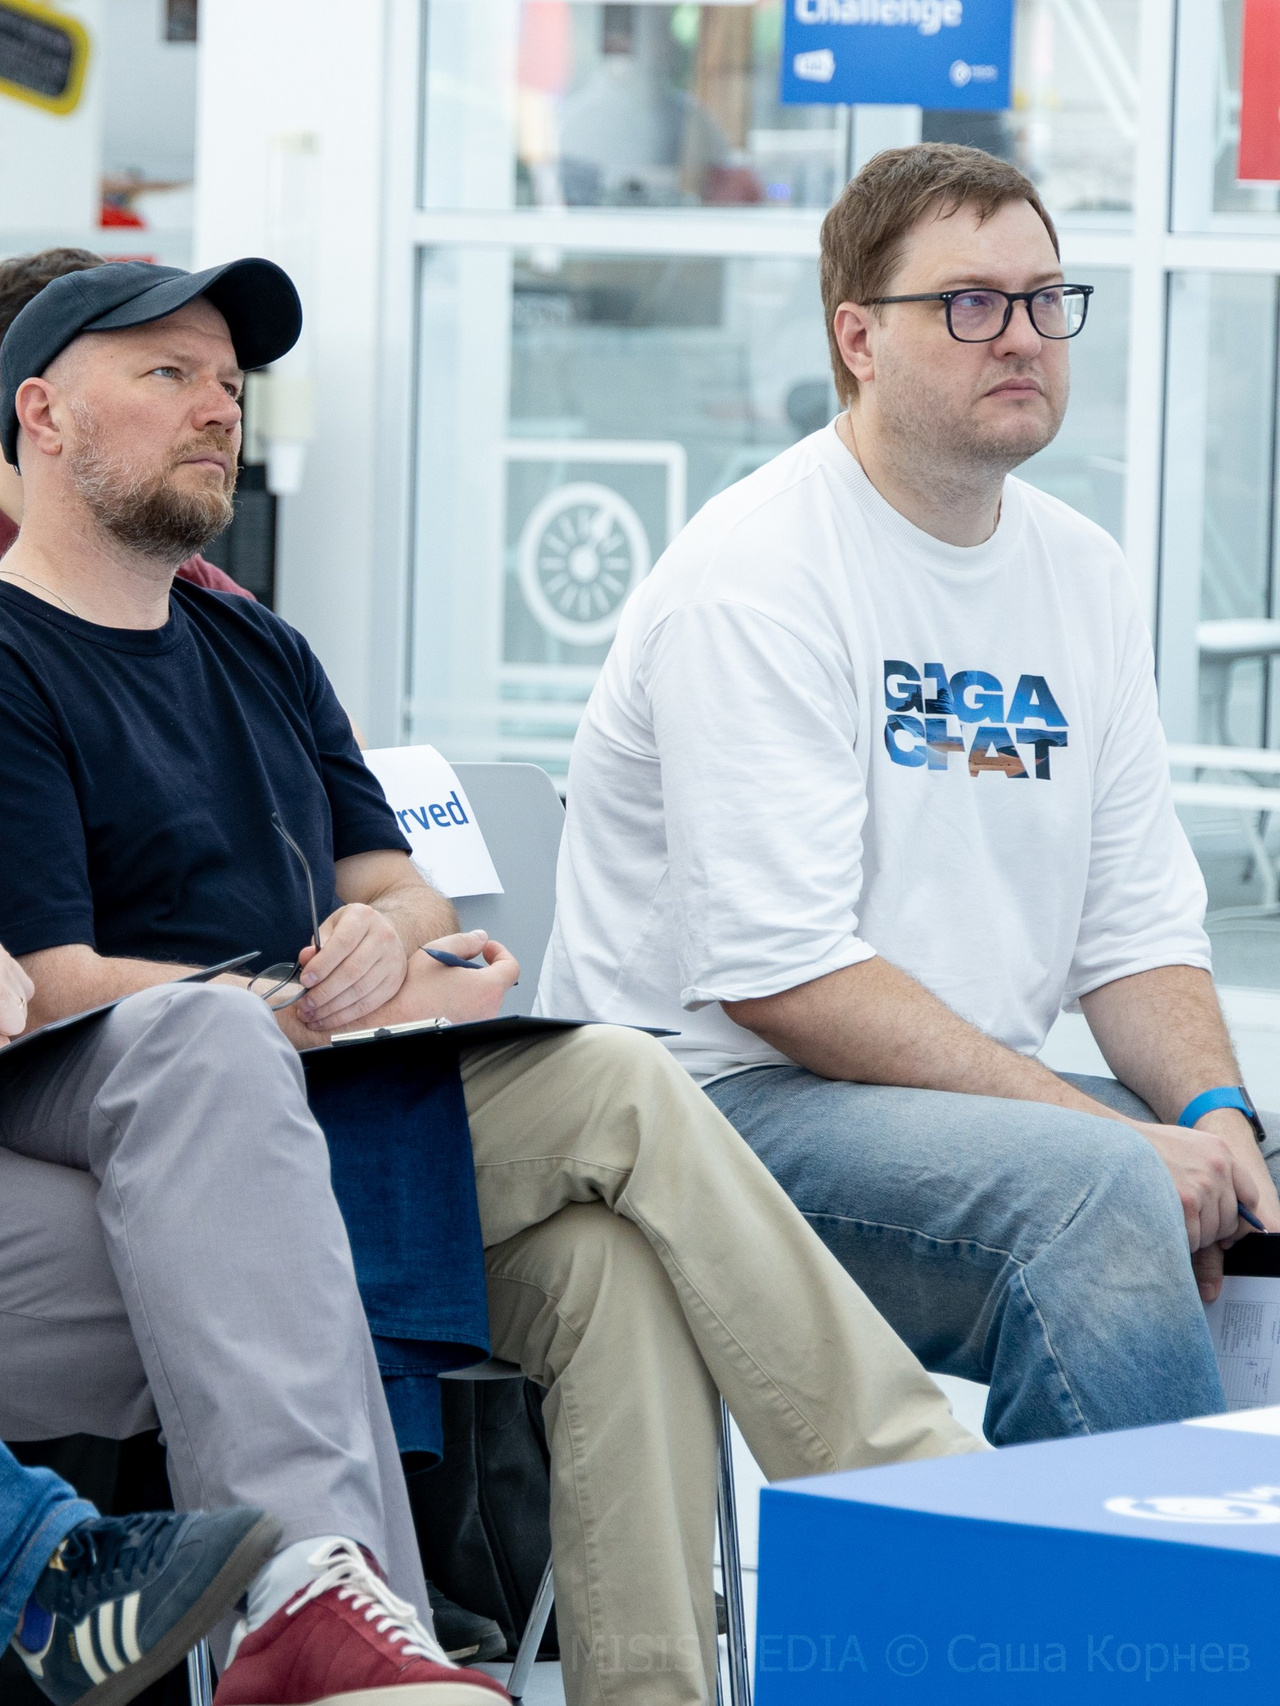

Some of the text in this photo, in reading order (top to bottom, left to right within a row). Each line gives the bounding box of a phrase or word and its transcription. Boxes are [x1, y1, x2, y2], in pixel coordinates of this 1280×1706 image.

[794, 0, 963, 35] Challenge
[883, 659, 1069, 727] GIGA
[395, 791, 469, 834] rved
